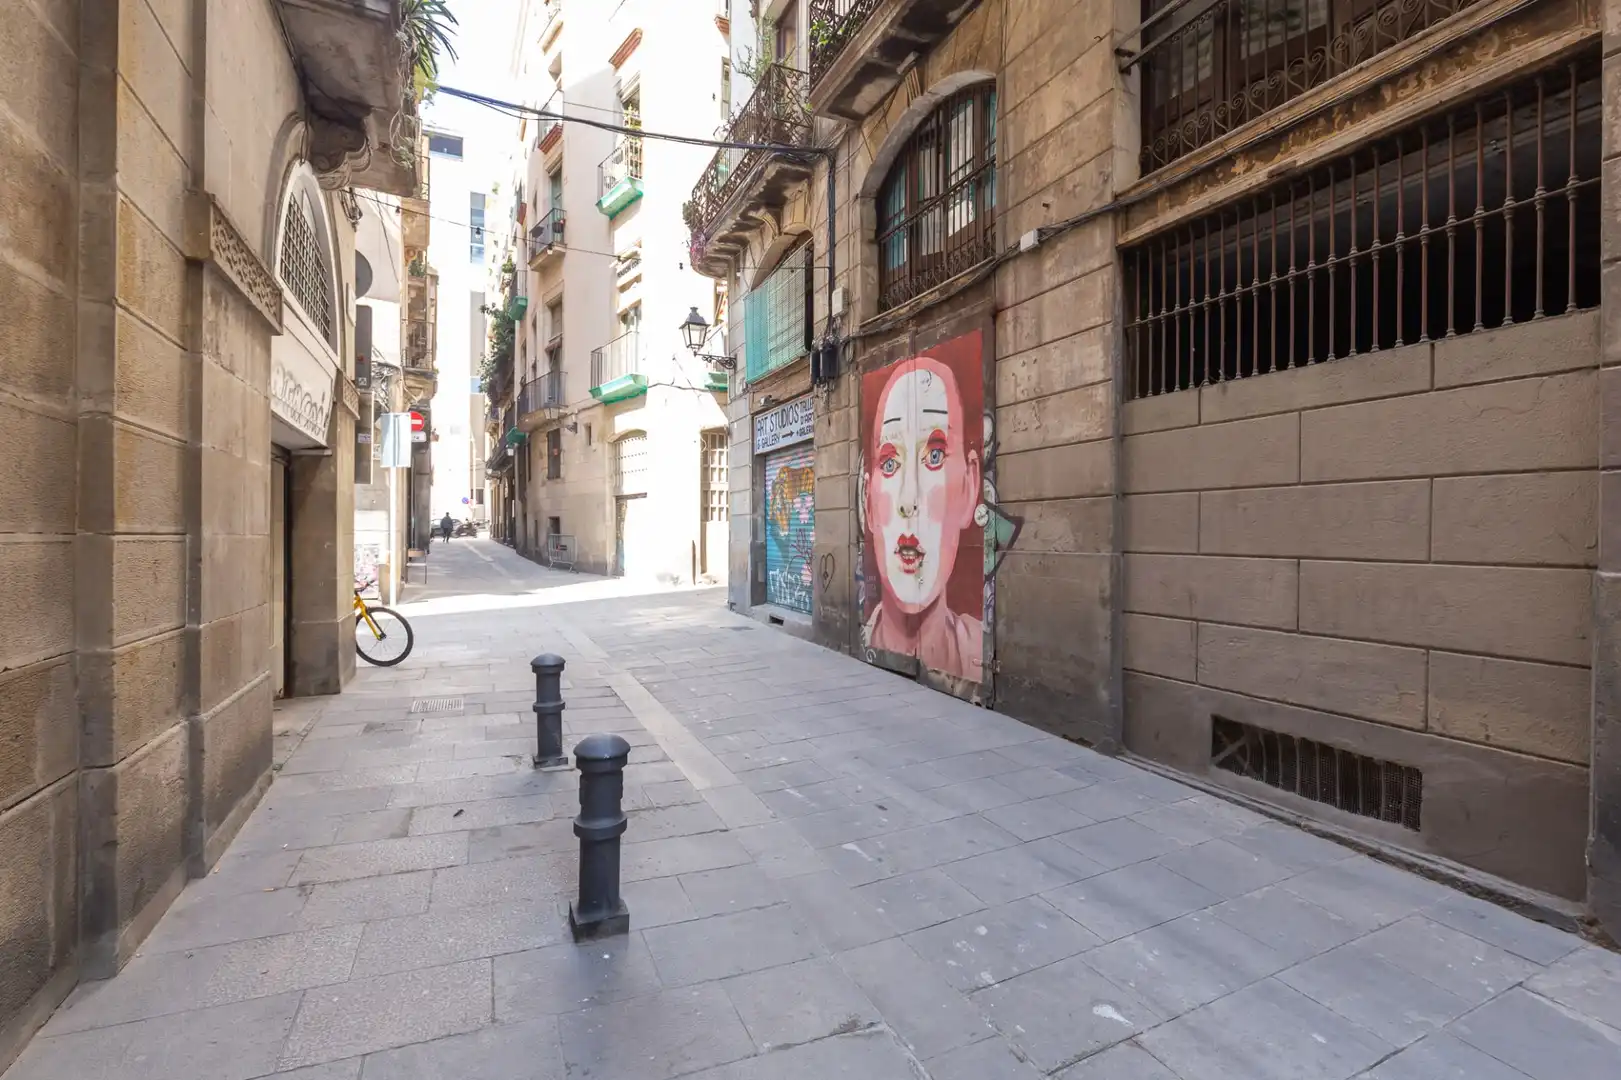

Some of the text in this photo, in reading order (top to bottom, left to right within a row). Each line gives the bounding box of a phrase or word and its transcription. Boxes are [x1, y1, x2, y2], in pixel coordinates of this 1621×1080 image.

[757, 403, 799, 437] ART STUDIOS
[761, 433, 780, 448] GALLERY
